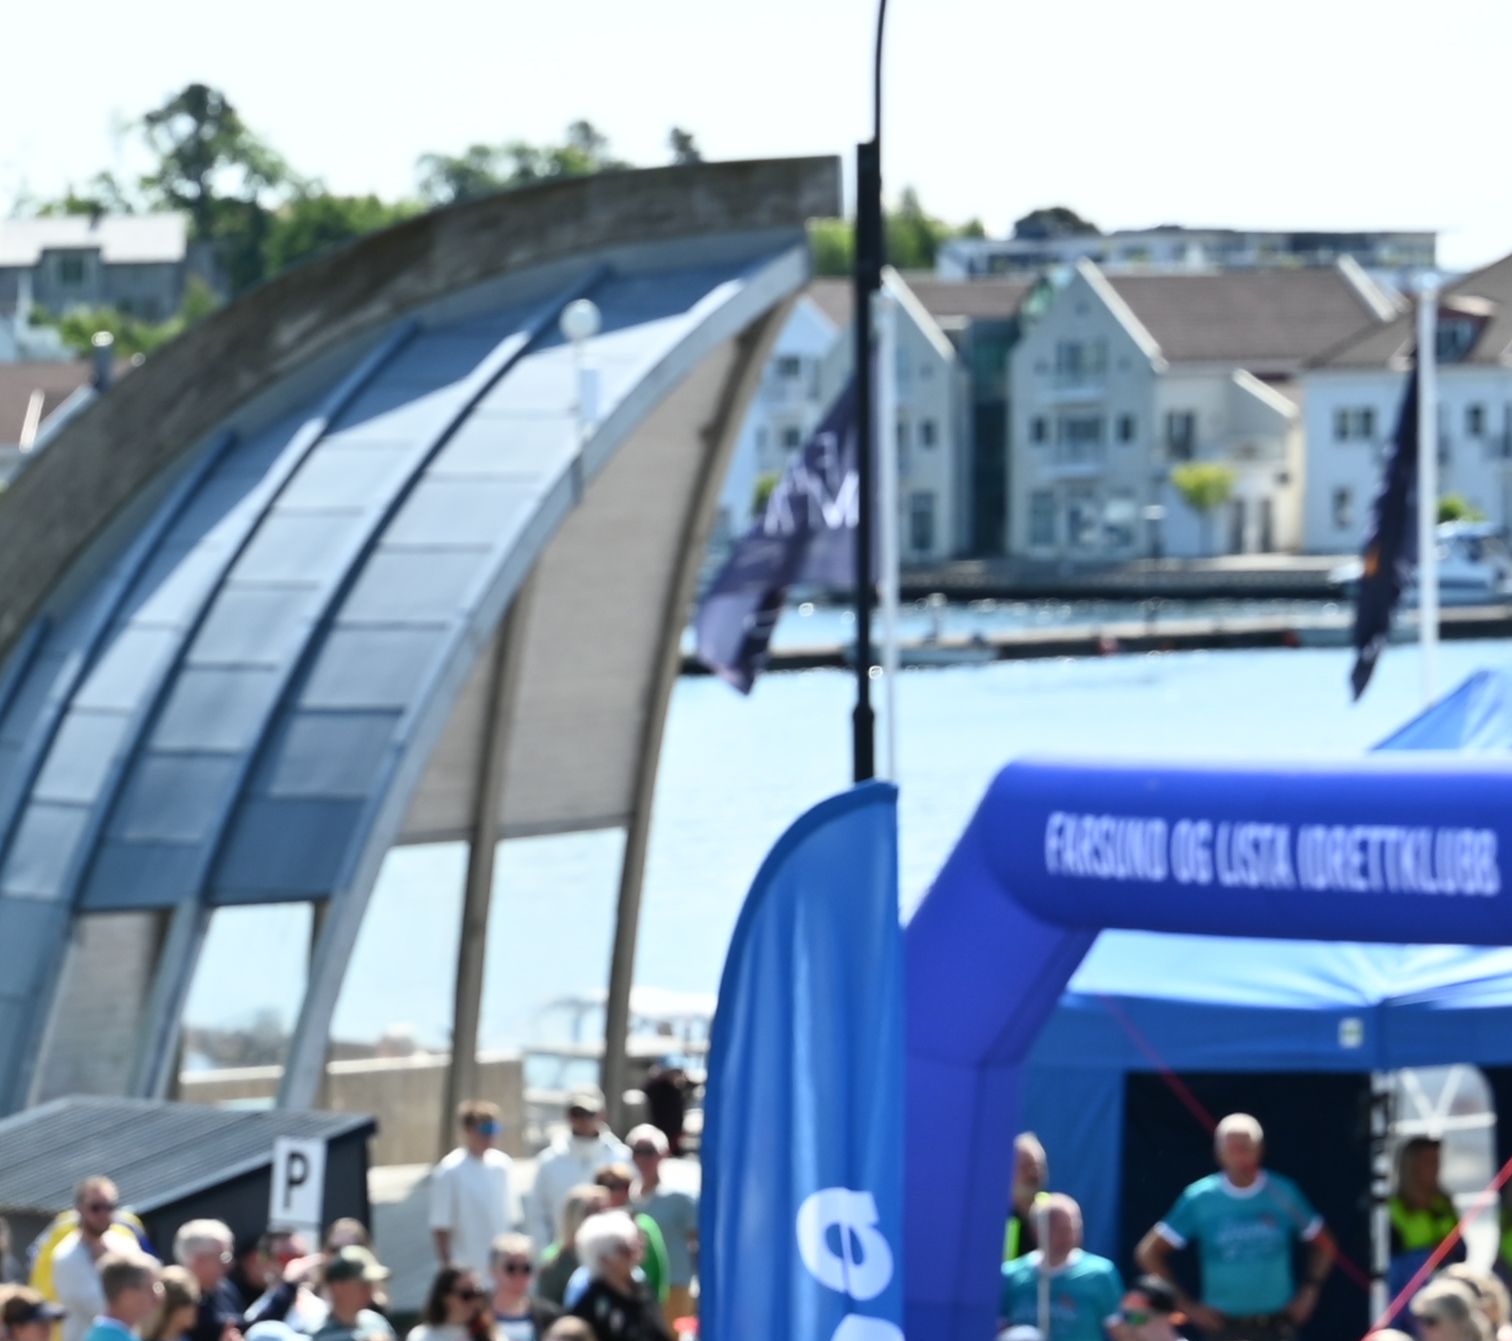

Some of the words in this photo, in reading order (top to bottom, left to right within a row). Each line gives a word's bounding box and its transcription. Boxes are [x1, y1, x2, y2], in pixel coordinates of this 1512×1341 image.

[1045, 811, 1168, 882] FARSUND
[1171, 818, 1213, 885] OG
[1216, 820, 1296, 891] LISTA
[286, 1150, 308, 1190] P
